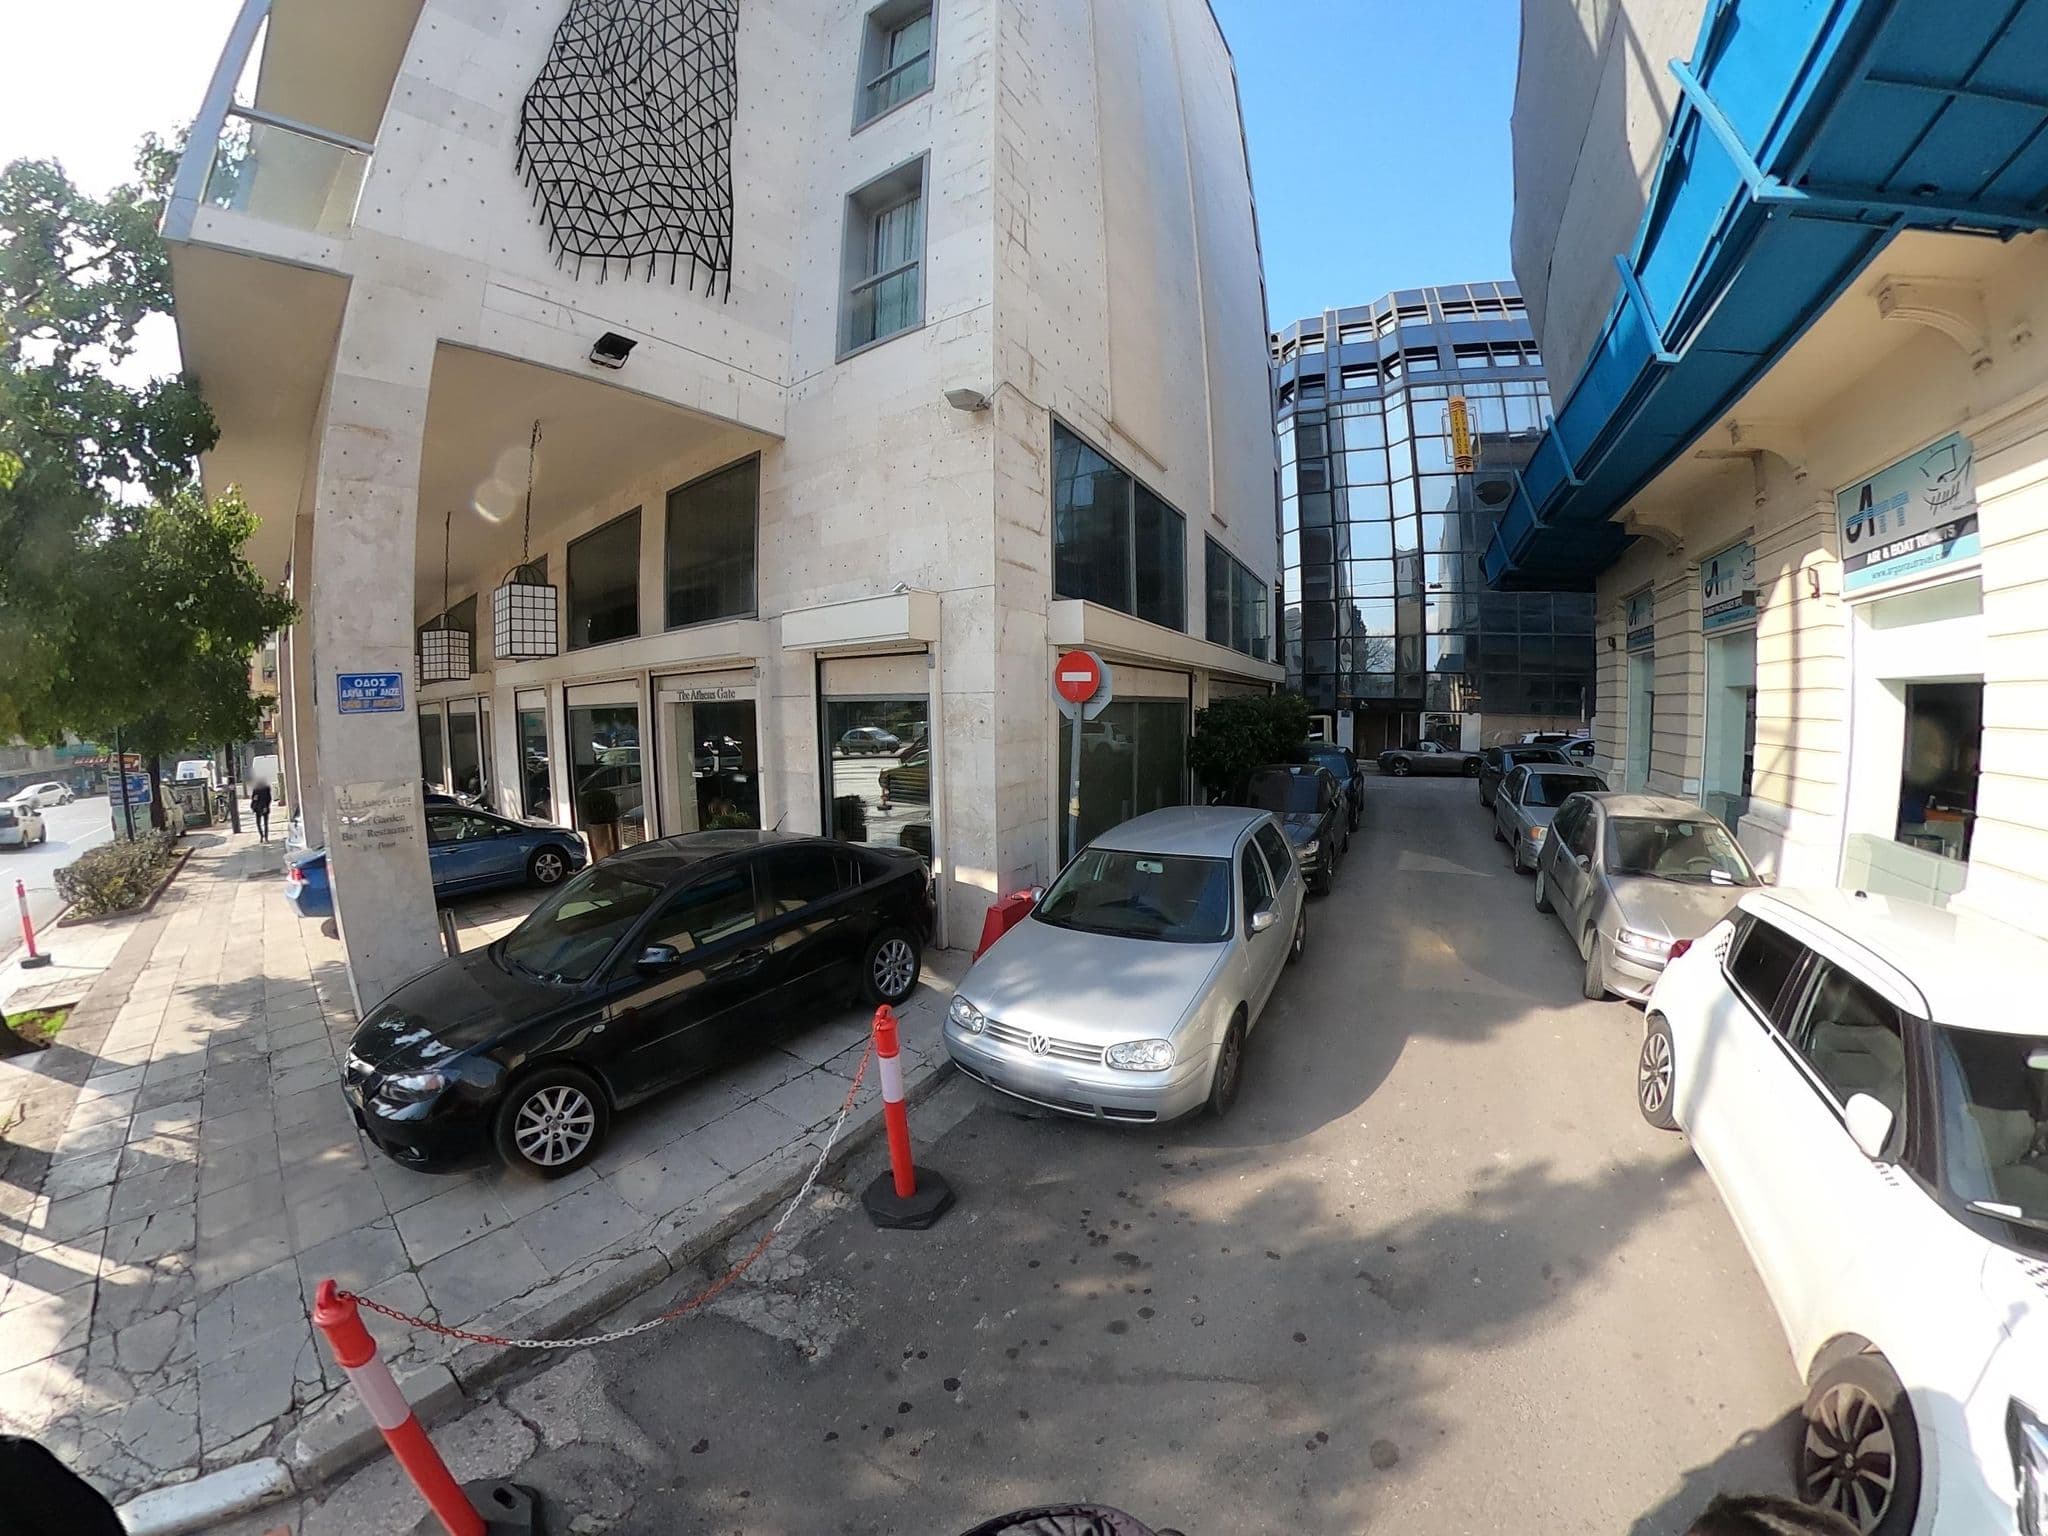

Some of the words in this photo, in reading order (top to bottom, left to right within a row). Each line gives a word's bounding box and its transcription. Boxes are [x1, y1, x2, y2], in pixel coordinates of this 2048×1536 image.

[1867, 550, 1882, 565] AIR
[1882, 548, 1889, 559] &
[1890, 539, 1914, 557] BOAT
[1915, 524, 1956, 547] TICTS
[354, 678, 387, 687] ΟΔΟΣ
[677, 691, 690, 701] The
[691, 690, 716, 701] Athens
[717, 688, 736, 700] Gate
[373, 814, 405, 825] Garden
[342, 832, 358, 841] Bar
[367, 825, 414, 837] Restaurant
